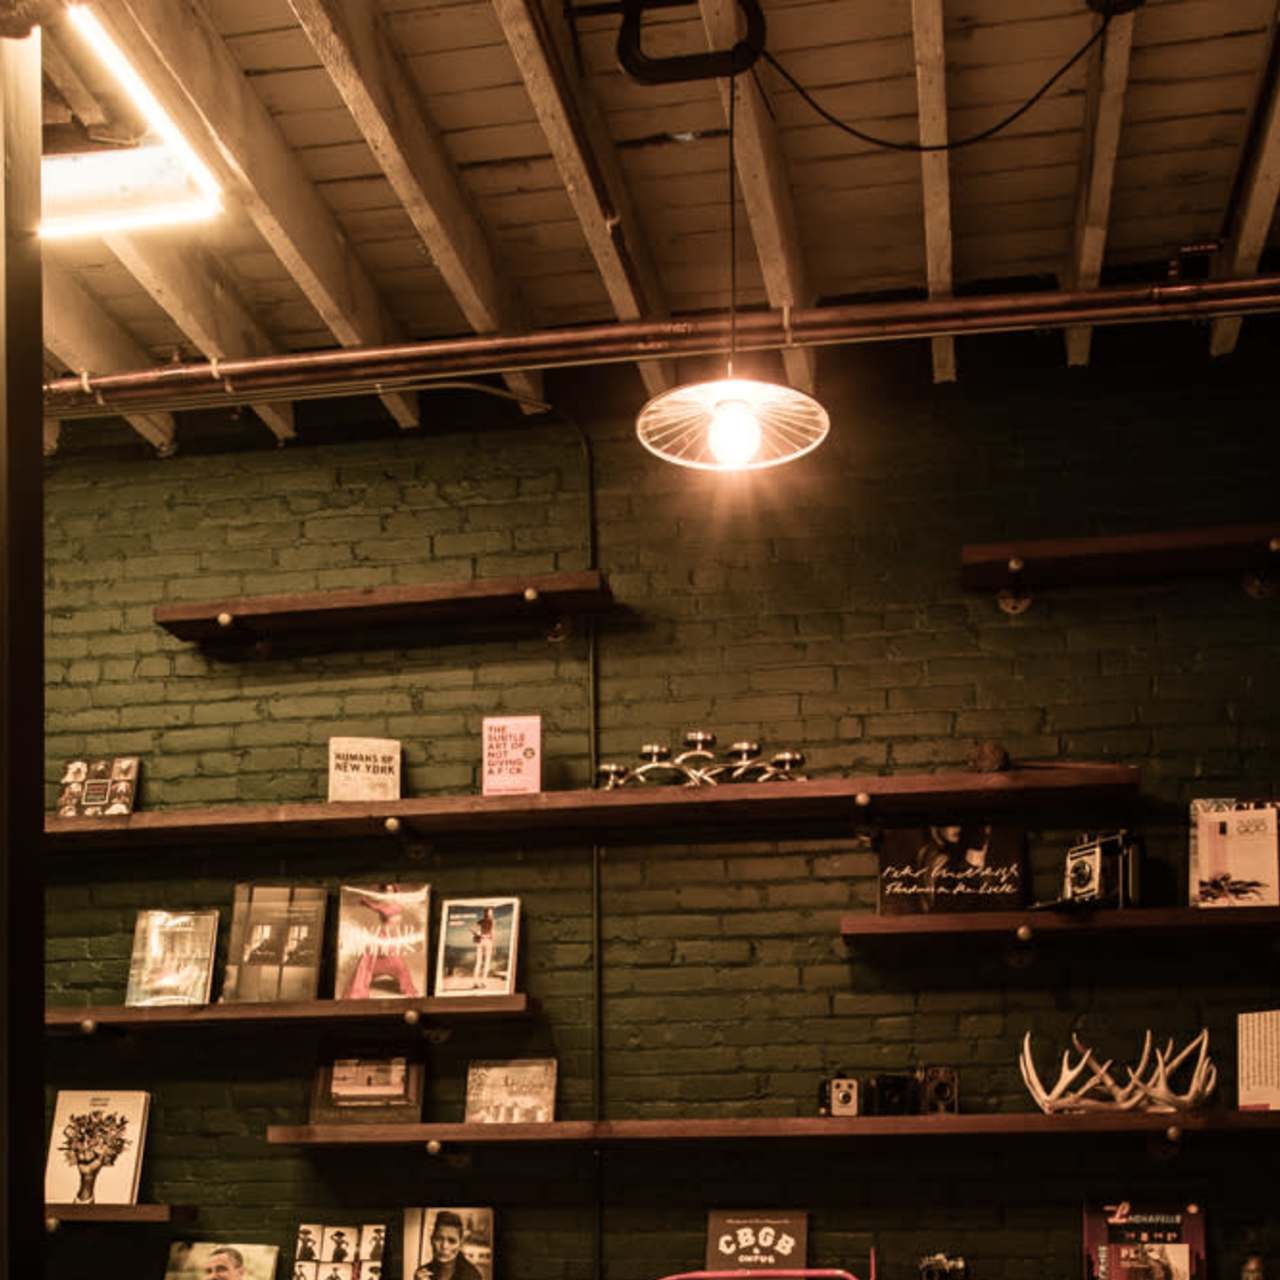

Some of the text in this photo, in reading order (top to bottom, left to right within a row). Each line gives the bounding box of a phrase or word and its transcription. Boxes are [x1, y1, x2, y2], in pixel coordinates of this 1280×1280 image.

[335, 753, 378, 763] HUMANS
[335, 762, 395, 775] NEW YORK
[718, 1226, 796, 1256] CBGB
